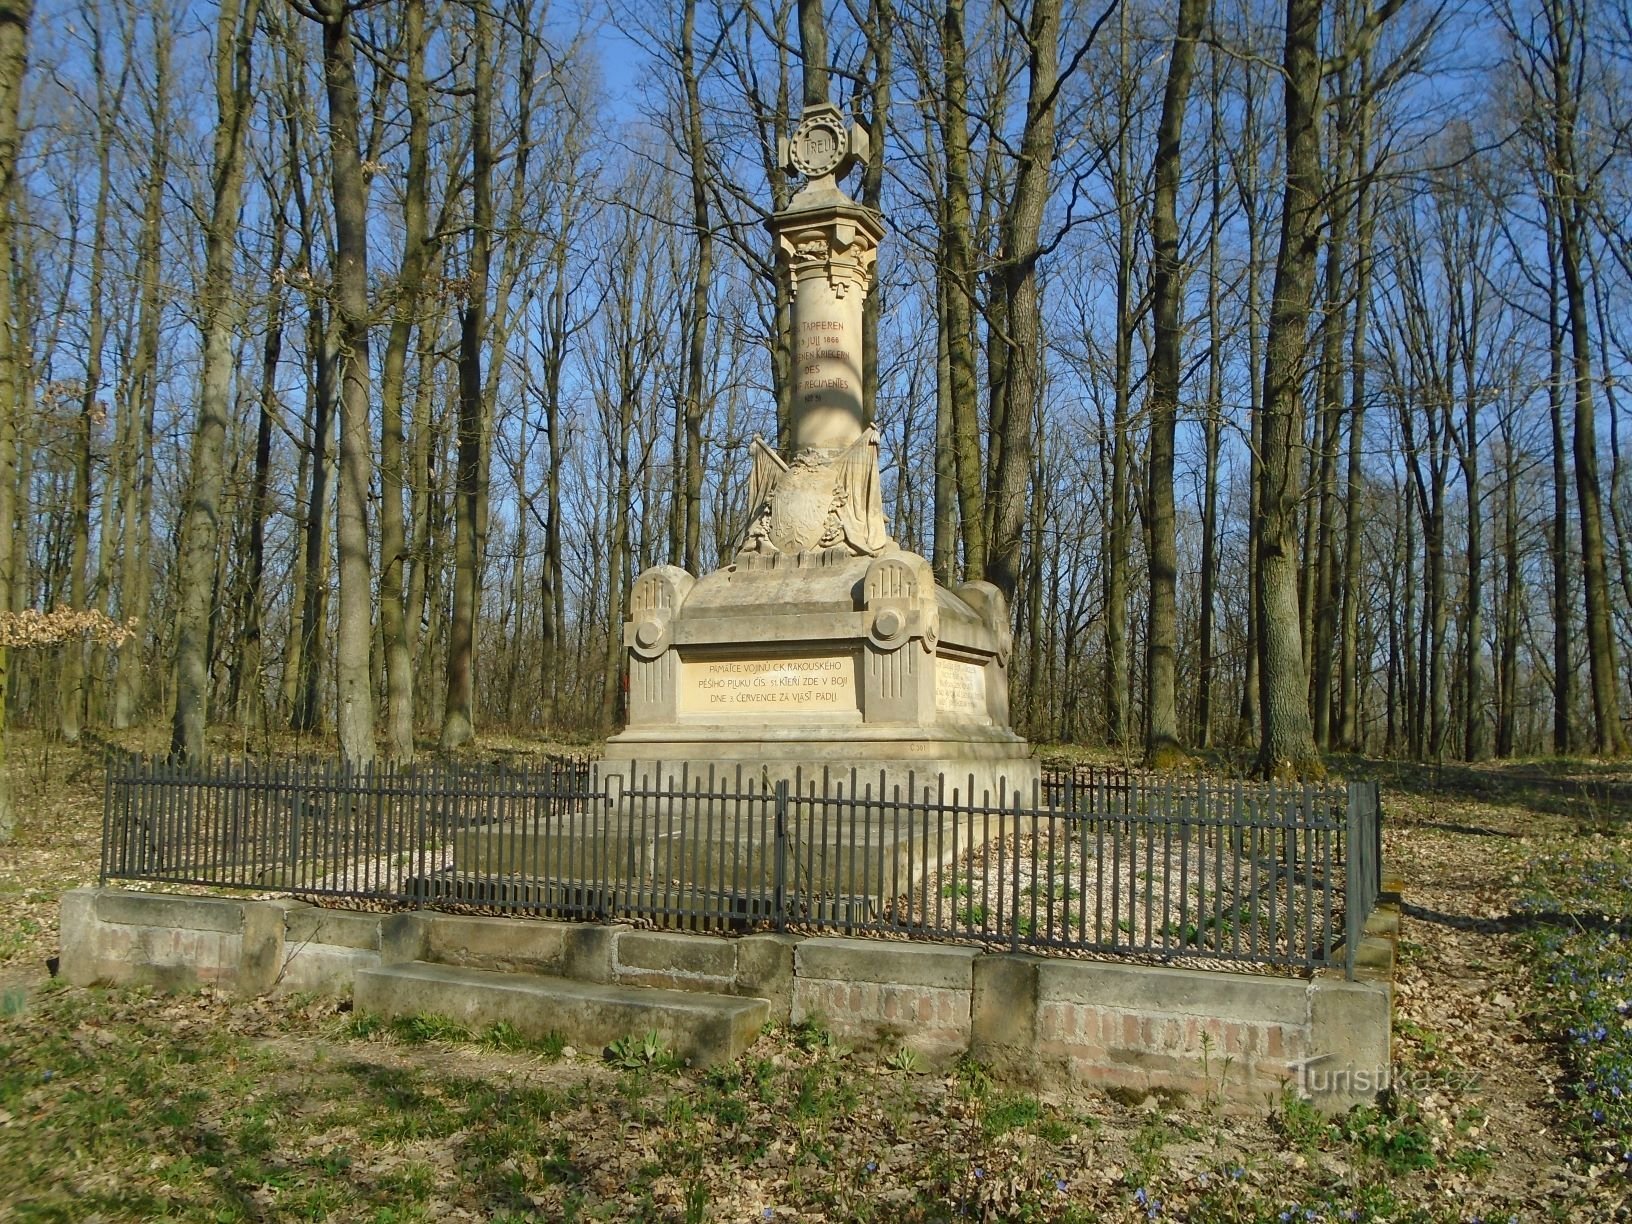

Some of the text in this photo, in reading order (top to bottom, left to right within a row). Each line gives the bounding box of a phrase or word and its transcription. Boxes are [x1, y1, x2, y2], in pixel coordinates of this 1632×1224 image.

[802, 321, 844, 331] TAPFEREN
[807, 336, 820, 348] JULI
[823, 336, 840, 344] 1866
[804, 364, 821, 374] DES
[727, 679, 751, 689] PLUKU
[803, 677, 819, 686] ZDE
[831, 676, 848, 687] BOJI
[710, 694, 727, 703] DNE
[736, 692, 776, 702] ČERVENCE
[779, 692, 789, 701] ZA
[792, 690, 812, 703] VLAST
